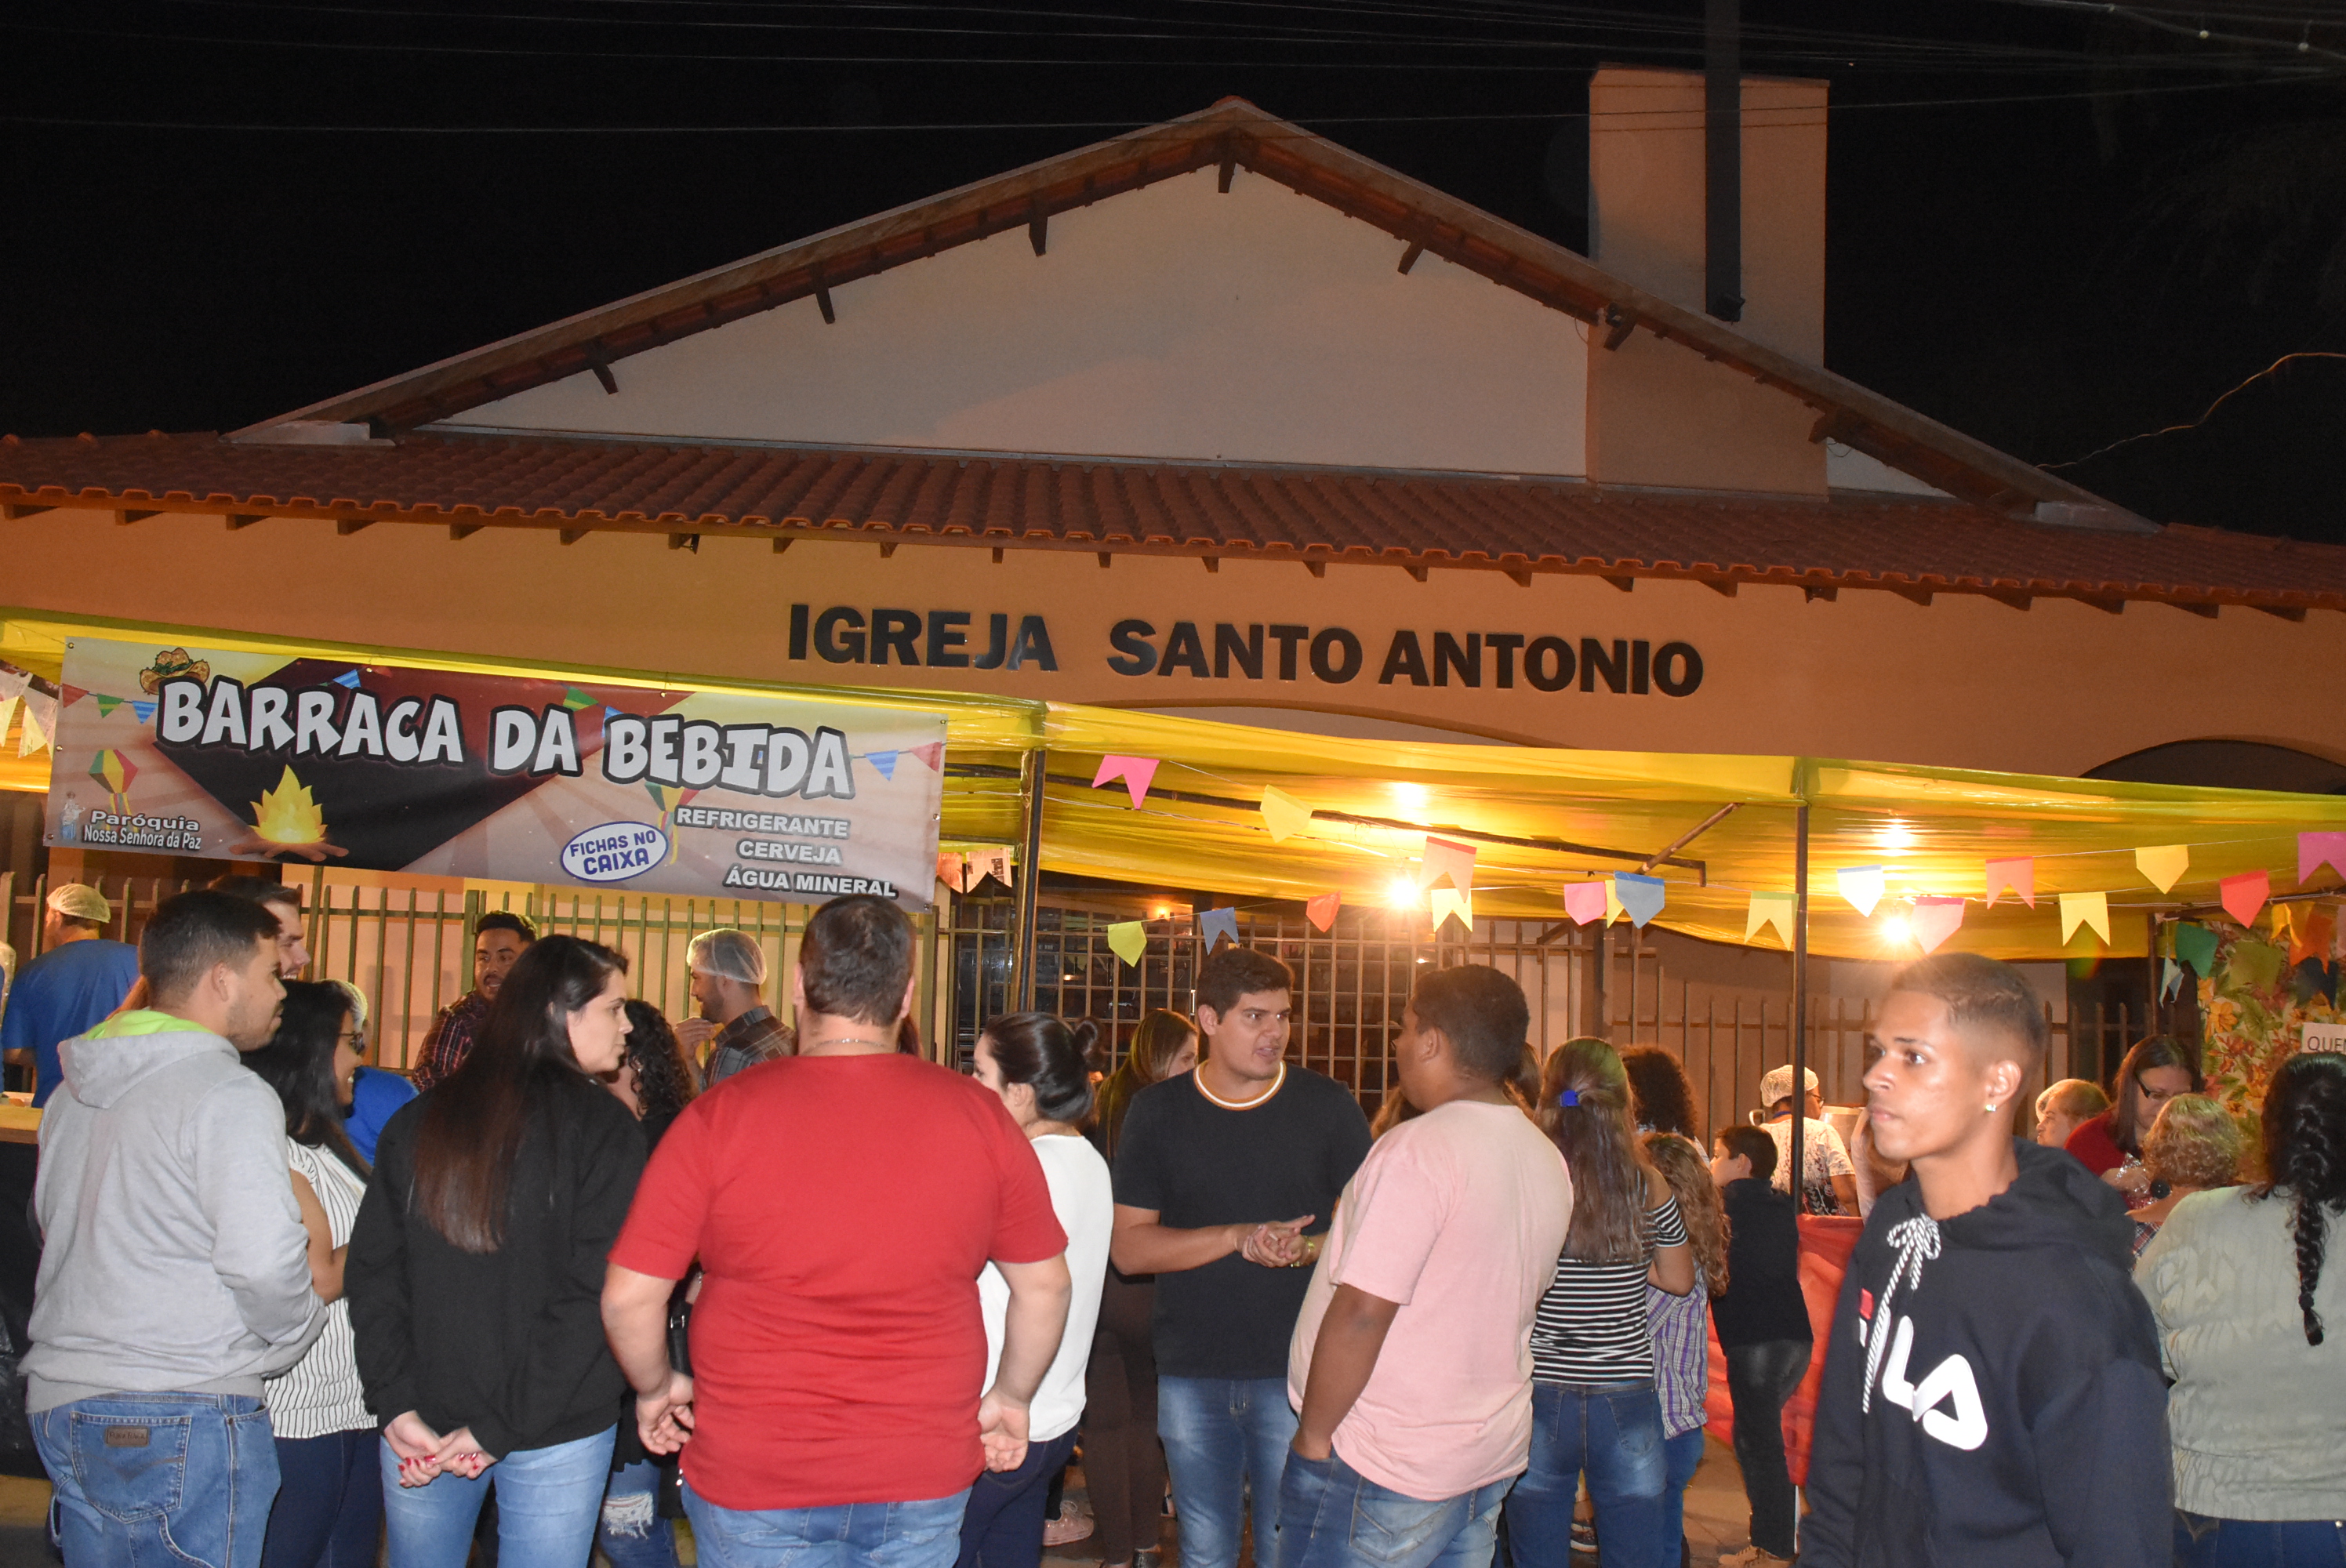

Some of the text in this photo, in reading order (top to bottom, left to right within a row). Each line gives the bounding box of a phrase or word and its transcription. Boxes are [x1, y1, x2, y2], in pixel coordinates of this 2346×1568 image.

[788, 603, 1705, 698] IGREJA SANTO ANTONIO
[160, 678, 853, 798] BARRACA DA BEBIDA
[90, 810, 201, 831] Paróquia
[676, 807, 849, 837] REFRIGERANTE
[83, 825, 202, 850] Nossa Senhora da Paz
[569, 829, 657, 858] FICHAS NO
[739, 840, 842, 864] CERVEJA
[583, 847, 650, 876] CAIXA
[725, 866, 898, 898] ÁGUA MINERAL
[2307, 1035, 2346, 1053] QUE
